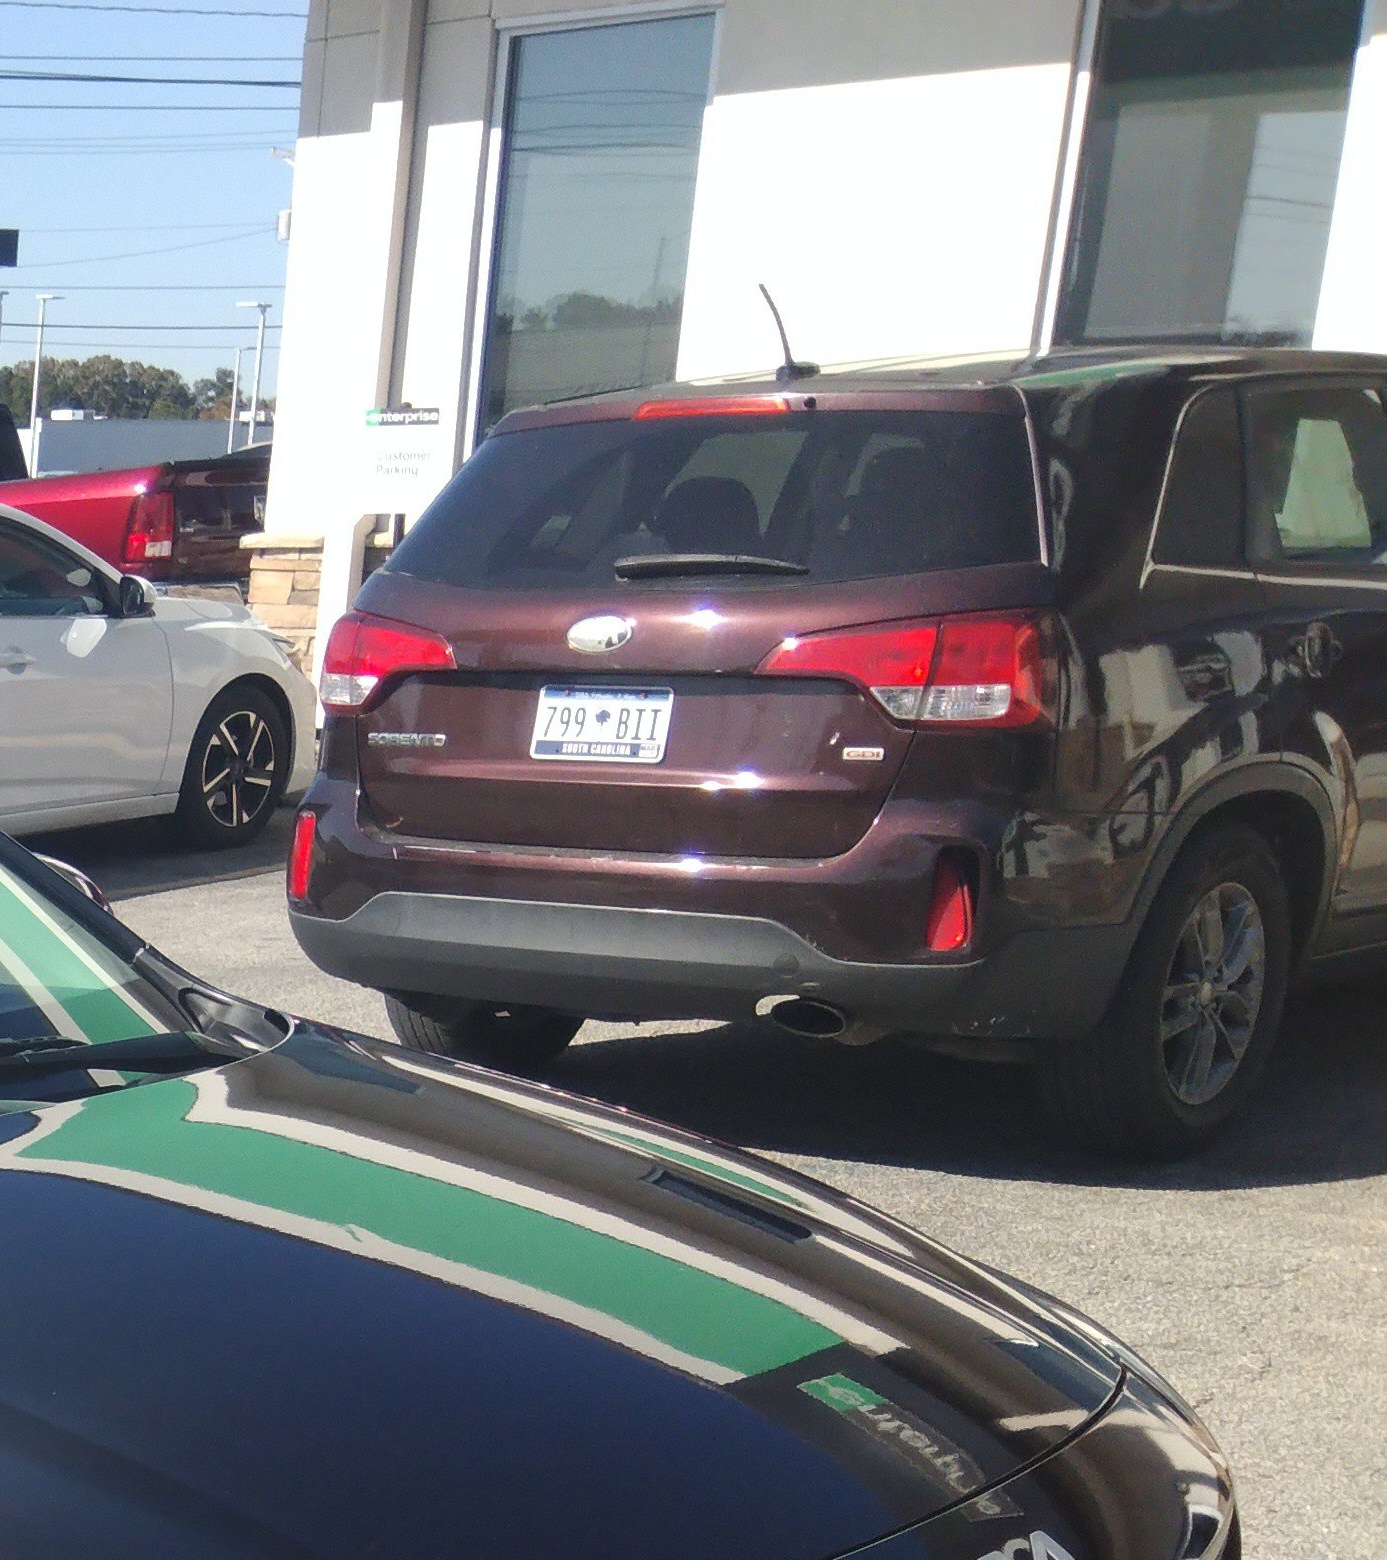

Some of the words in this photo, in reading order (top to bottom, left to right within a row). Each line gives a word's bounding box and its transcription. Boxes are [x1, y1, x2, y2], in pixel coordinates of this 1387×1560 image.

[367, 410, 439, 424] enterprise
[376, 464, 419, 477] Parking
[543, 706, 587, 738] 799
[615, 707, 662, 740] BII
[561, 742, 589, 754] SOUTH
[590, 743, 631, 756] CAROLINA
